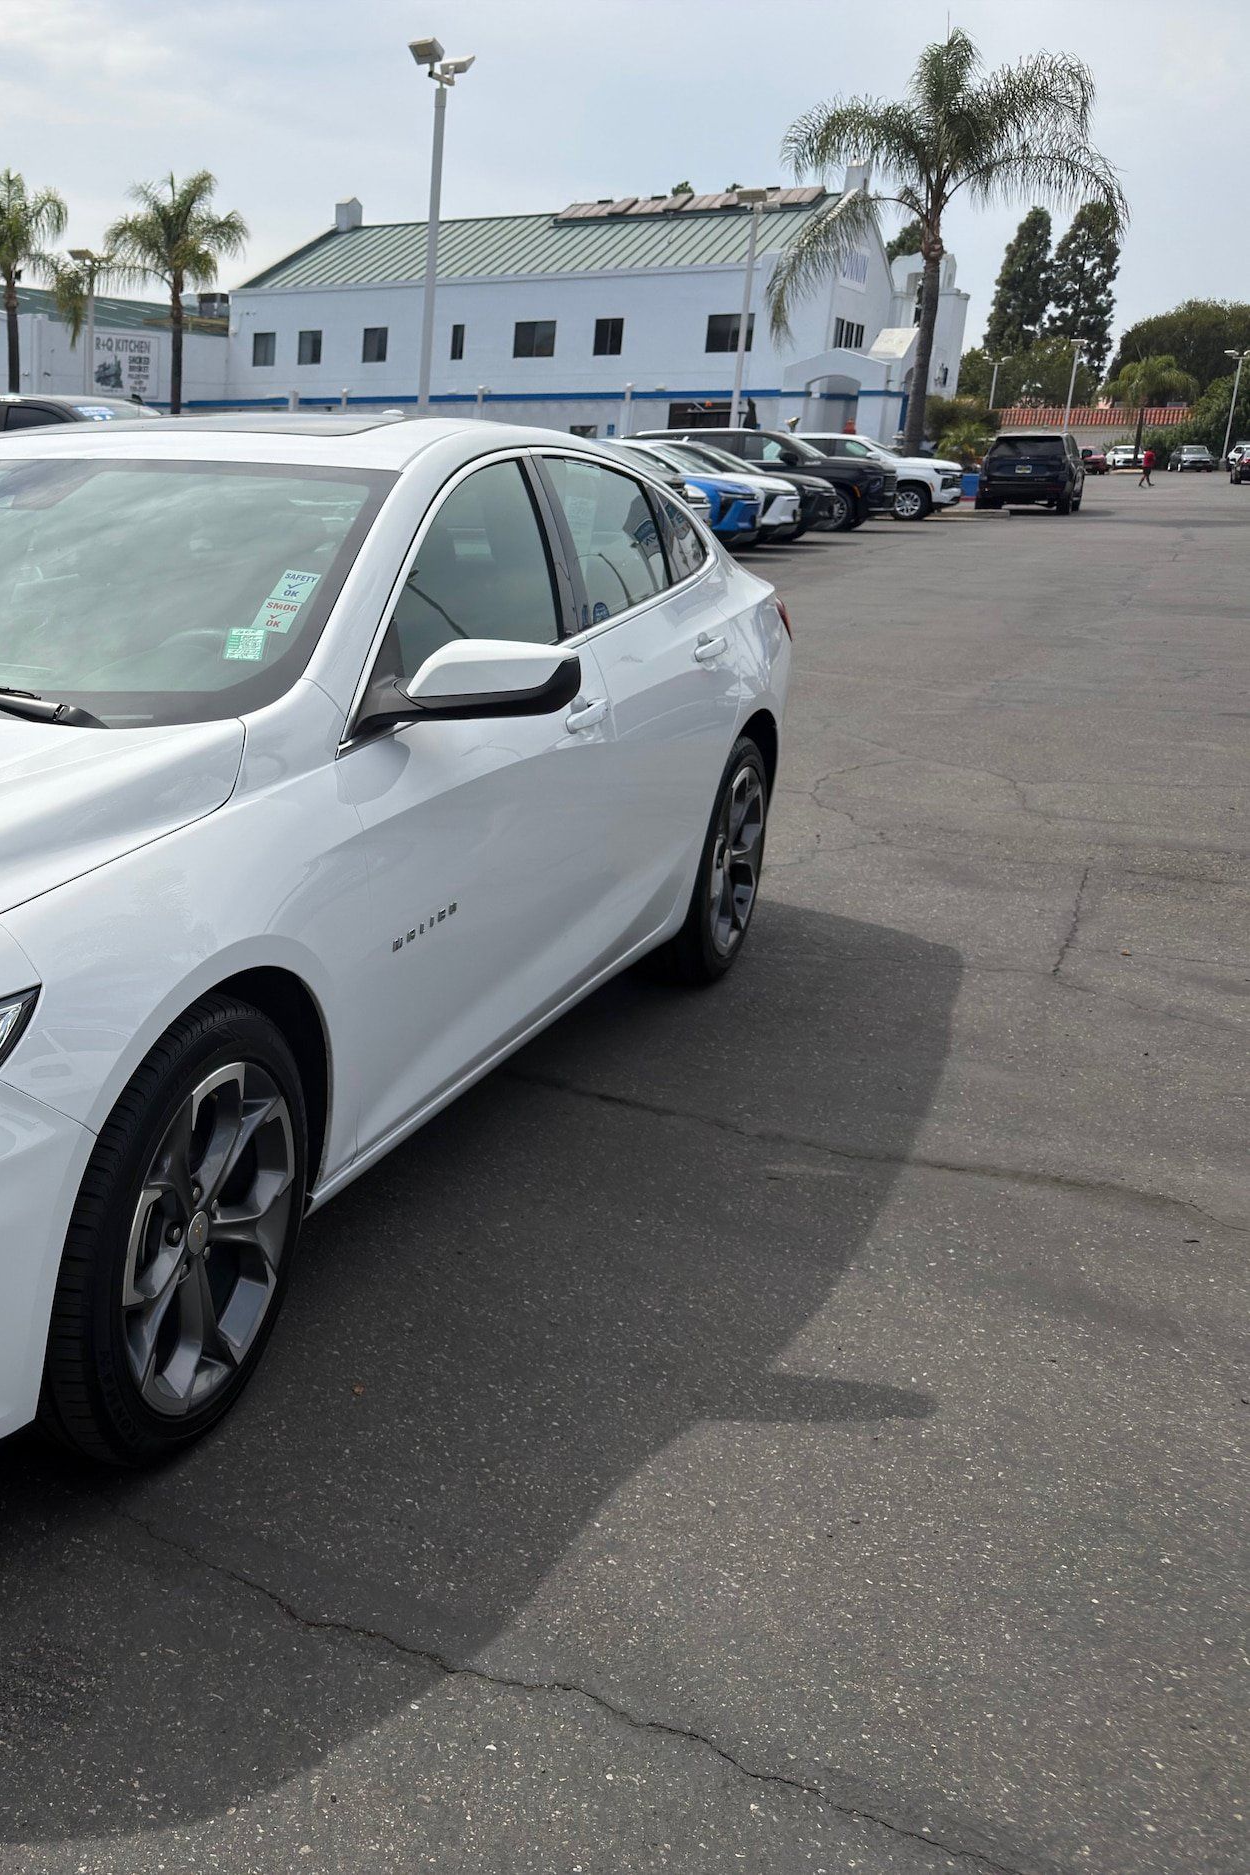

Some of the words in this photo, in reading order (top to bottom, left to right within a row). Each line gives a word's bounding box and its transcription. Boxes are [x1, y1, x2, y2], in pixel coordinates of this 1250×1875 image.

[115, 338, 151, 354] KITCHEN
[284, 573, 318, 583] SAFETY
[283, 589, 299, 598] OK
[266, 602, 298, 612] SMOG
[266, 619, 281, 628] OK
